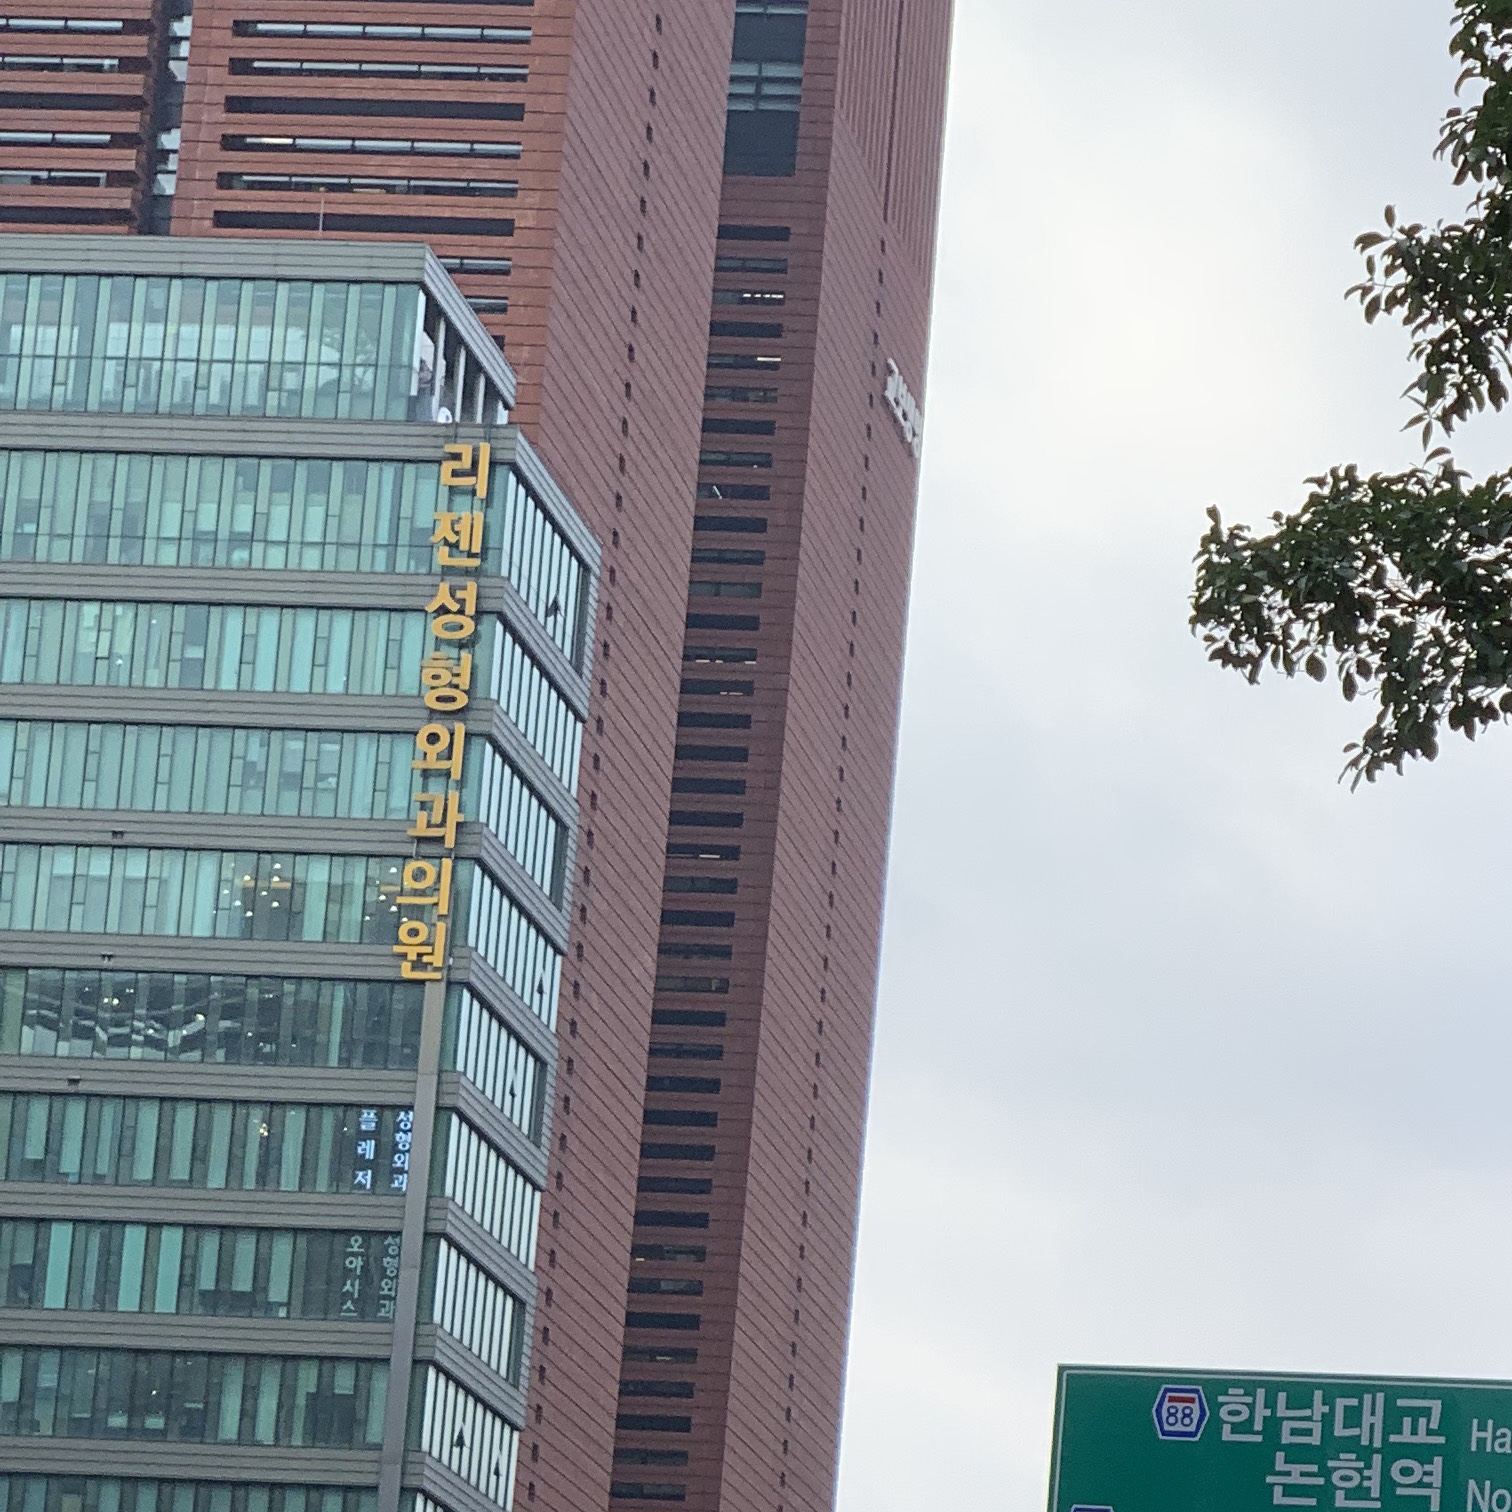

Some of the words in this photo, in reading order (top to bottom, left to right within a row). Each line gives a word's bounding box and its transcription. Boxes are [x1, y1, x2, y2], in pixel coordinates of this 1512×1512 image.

[392, 441, 490, 980] 리젠성형외과의원
[353, 1109, 379, 1190] 플레저
[390, 1110, 414, 1192] 성형외과
[340, 1235, 365, 1316] 오아시스
[1165, 1405, 1194, 1428] 88
[1217, 1387, 1447, 1448] 한남대교
[1265, 1451, 1443, 1512] 논현역
